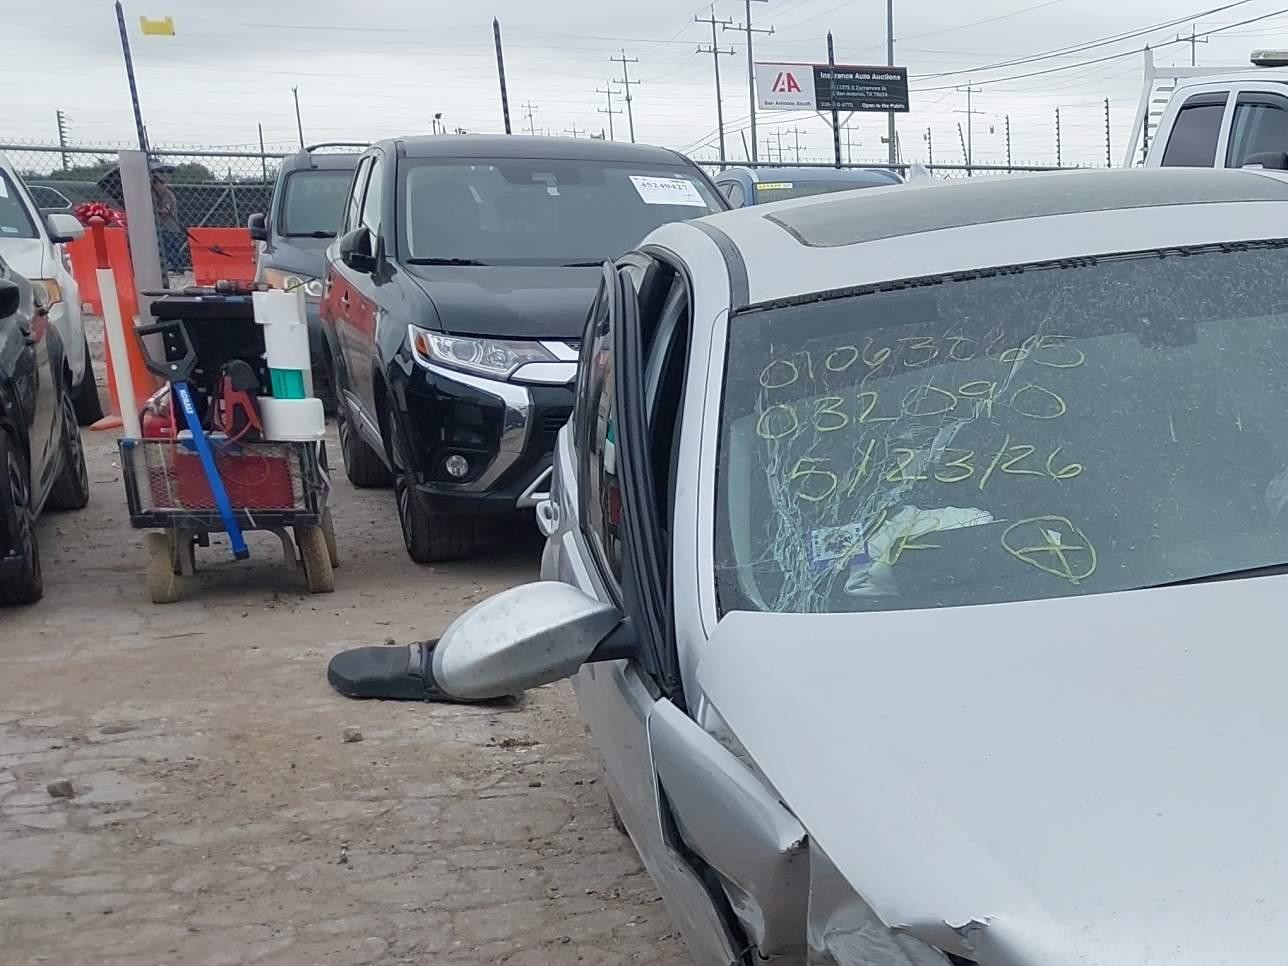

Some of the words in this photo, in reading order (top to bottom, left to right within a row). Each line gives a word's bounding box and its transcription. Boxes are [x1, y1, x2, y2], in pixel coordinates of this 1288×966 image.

[820, 71, 853, 79] Insrance
[872, 73, 901, 81] Auctions
[789, 434, 1084, 500] 5/23/26
